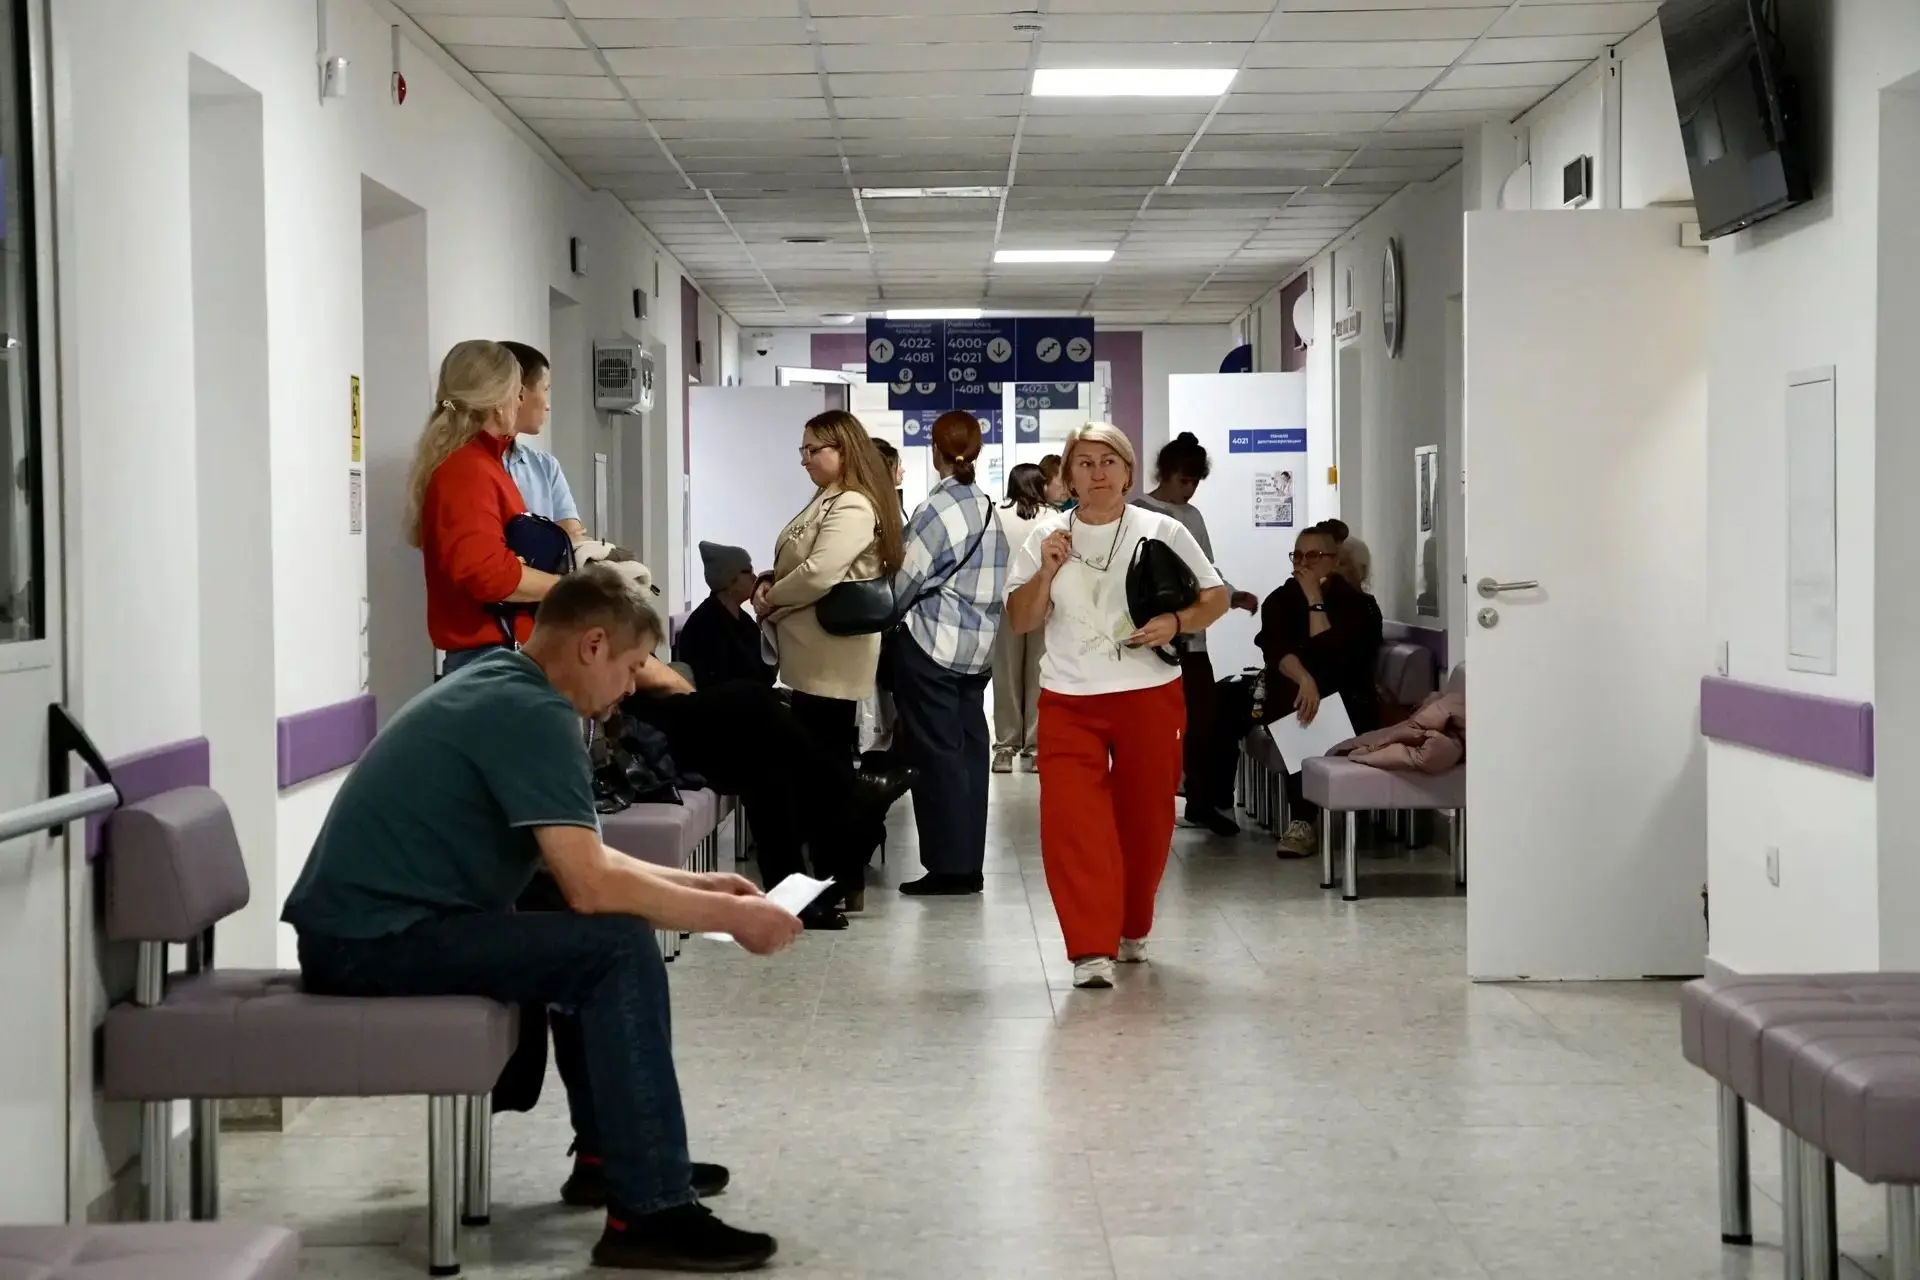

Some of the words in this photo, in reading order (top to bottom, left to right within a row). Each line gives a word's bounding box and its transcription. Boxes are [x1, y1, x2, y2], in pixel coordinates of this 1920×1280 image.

[899, 338, 936, 349] 4022-
[947, 338, 987, 349] 4000-
[899, 352, 934, 363] -4081
[947, 352, 982, 363] -4021
[955, 384, 984, 394] -4081
[1232, 437, 1249, 445] 4021
